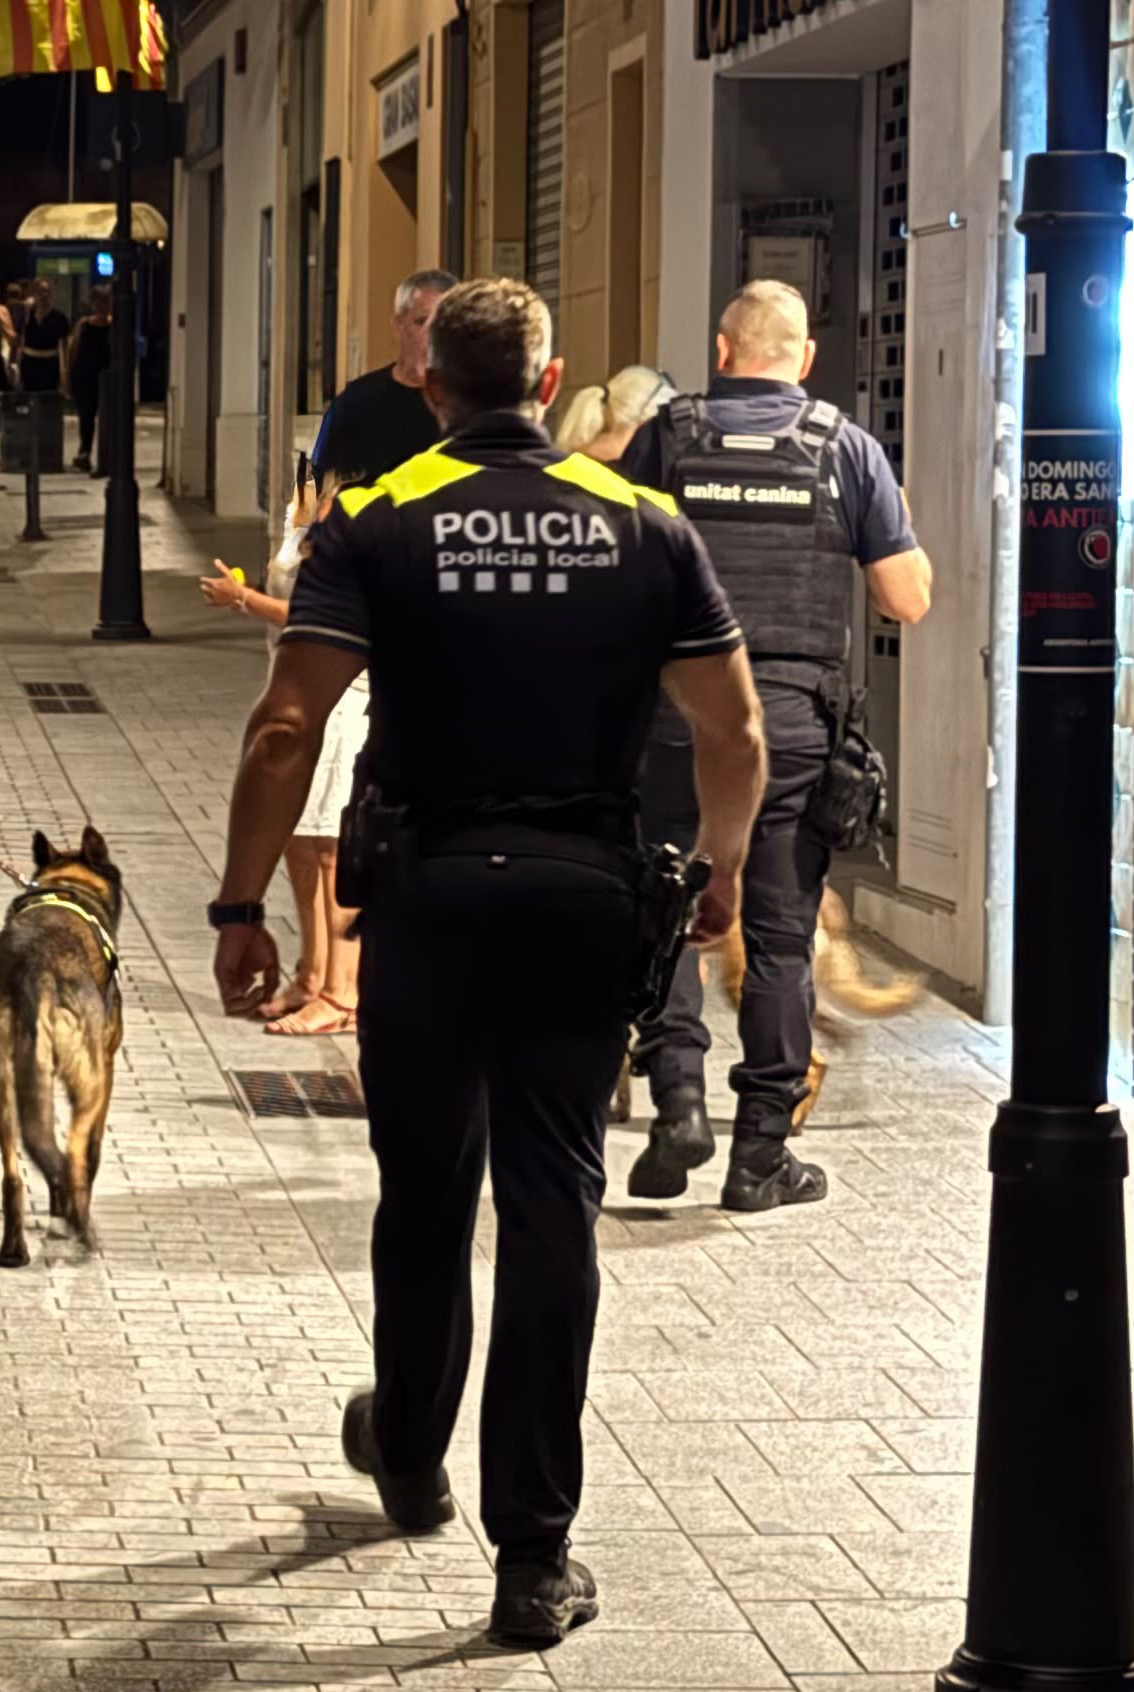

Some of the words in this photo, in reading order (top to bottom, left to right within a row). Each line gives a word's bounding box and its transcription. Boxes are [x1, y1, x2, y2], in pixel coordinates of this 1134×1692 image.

[683, 482, 741, 501] unitat
[744, 485, 811, 504] canina
[433, 509, 617, 546] POLICIA
[437, 548, 538, 569] policia
[547, 548, 619, 567] local
